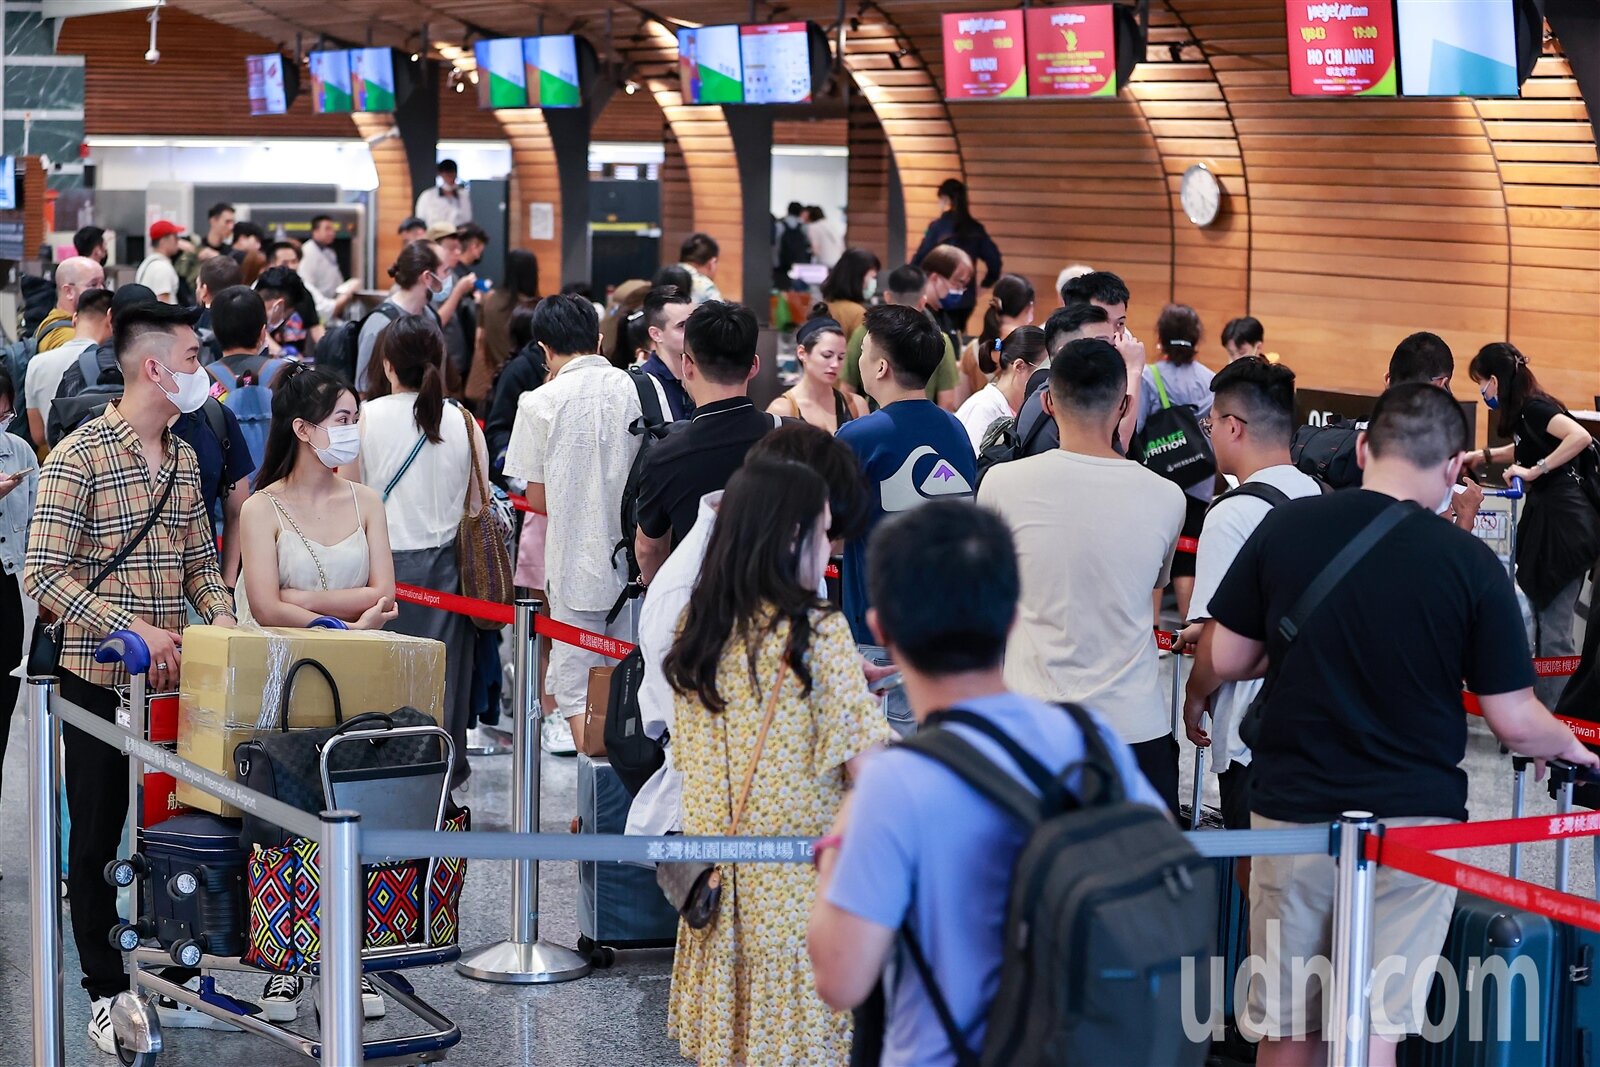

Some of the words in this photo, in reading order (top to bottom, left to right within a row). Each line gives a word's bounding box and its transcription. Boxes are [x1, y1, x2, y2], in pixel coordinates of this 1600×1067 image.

[1307, 48, 1323, 65] HO
[1324, 48, 1343, 65] CHI
[1344, 48, 1375, 65] MINH
[396, 587, 423, 600] nternational
[423, 592, 440, 605] Airport
[648, 841, 793, 860] 臺灣桃園國際機場
